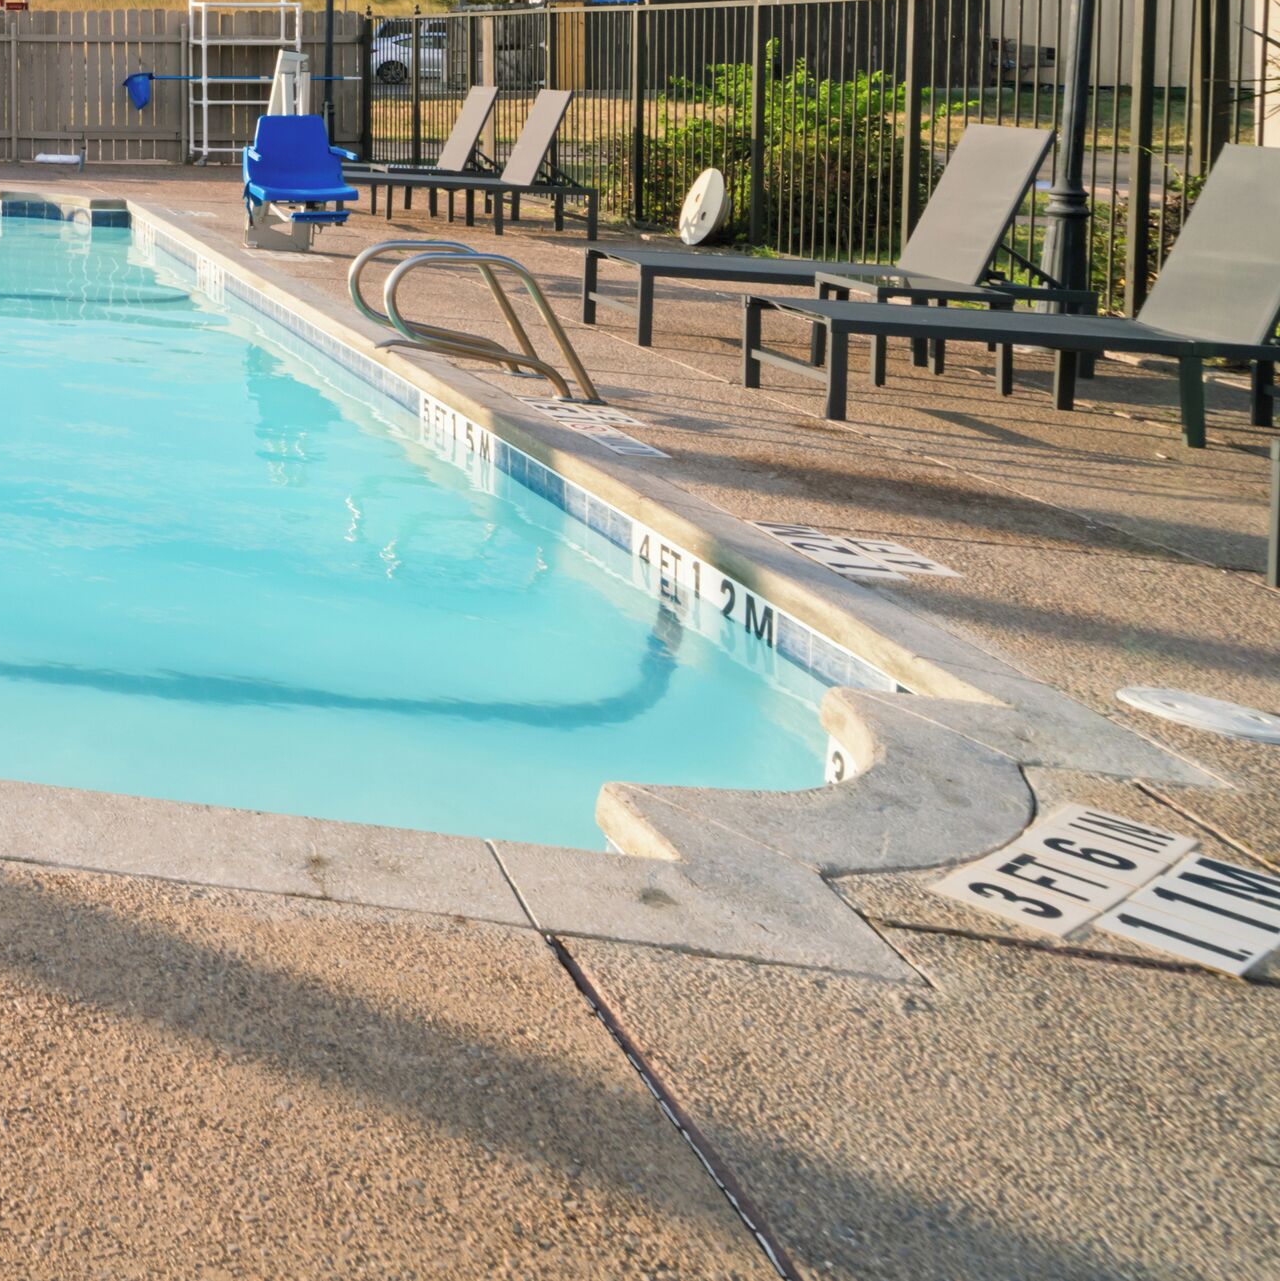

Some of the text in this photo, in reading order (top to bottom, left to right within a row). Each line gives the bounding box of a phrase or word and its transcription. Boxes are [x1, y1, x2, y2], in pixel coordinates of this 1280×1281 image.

[639, 535, 649, 564] 4
[660, 544, 682, 579] FT
[968, 811, 1175, 919] 3 FT 6 IN
